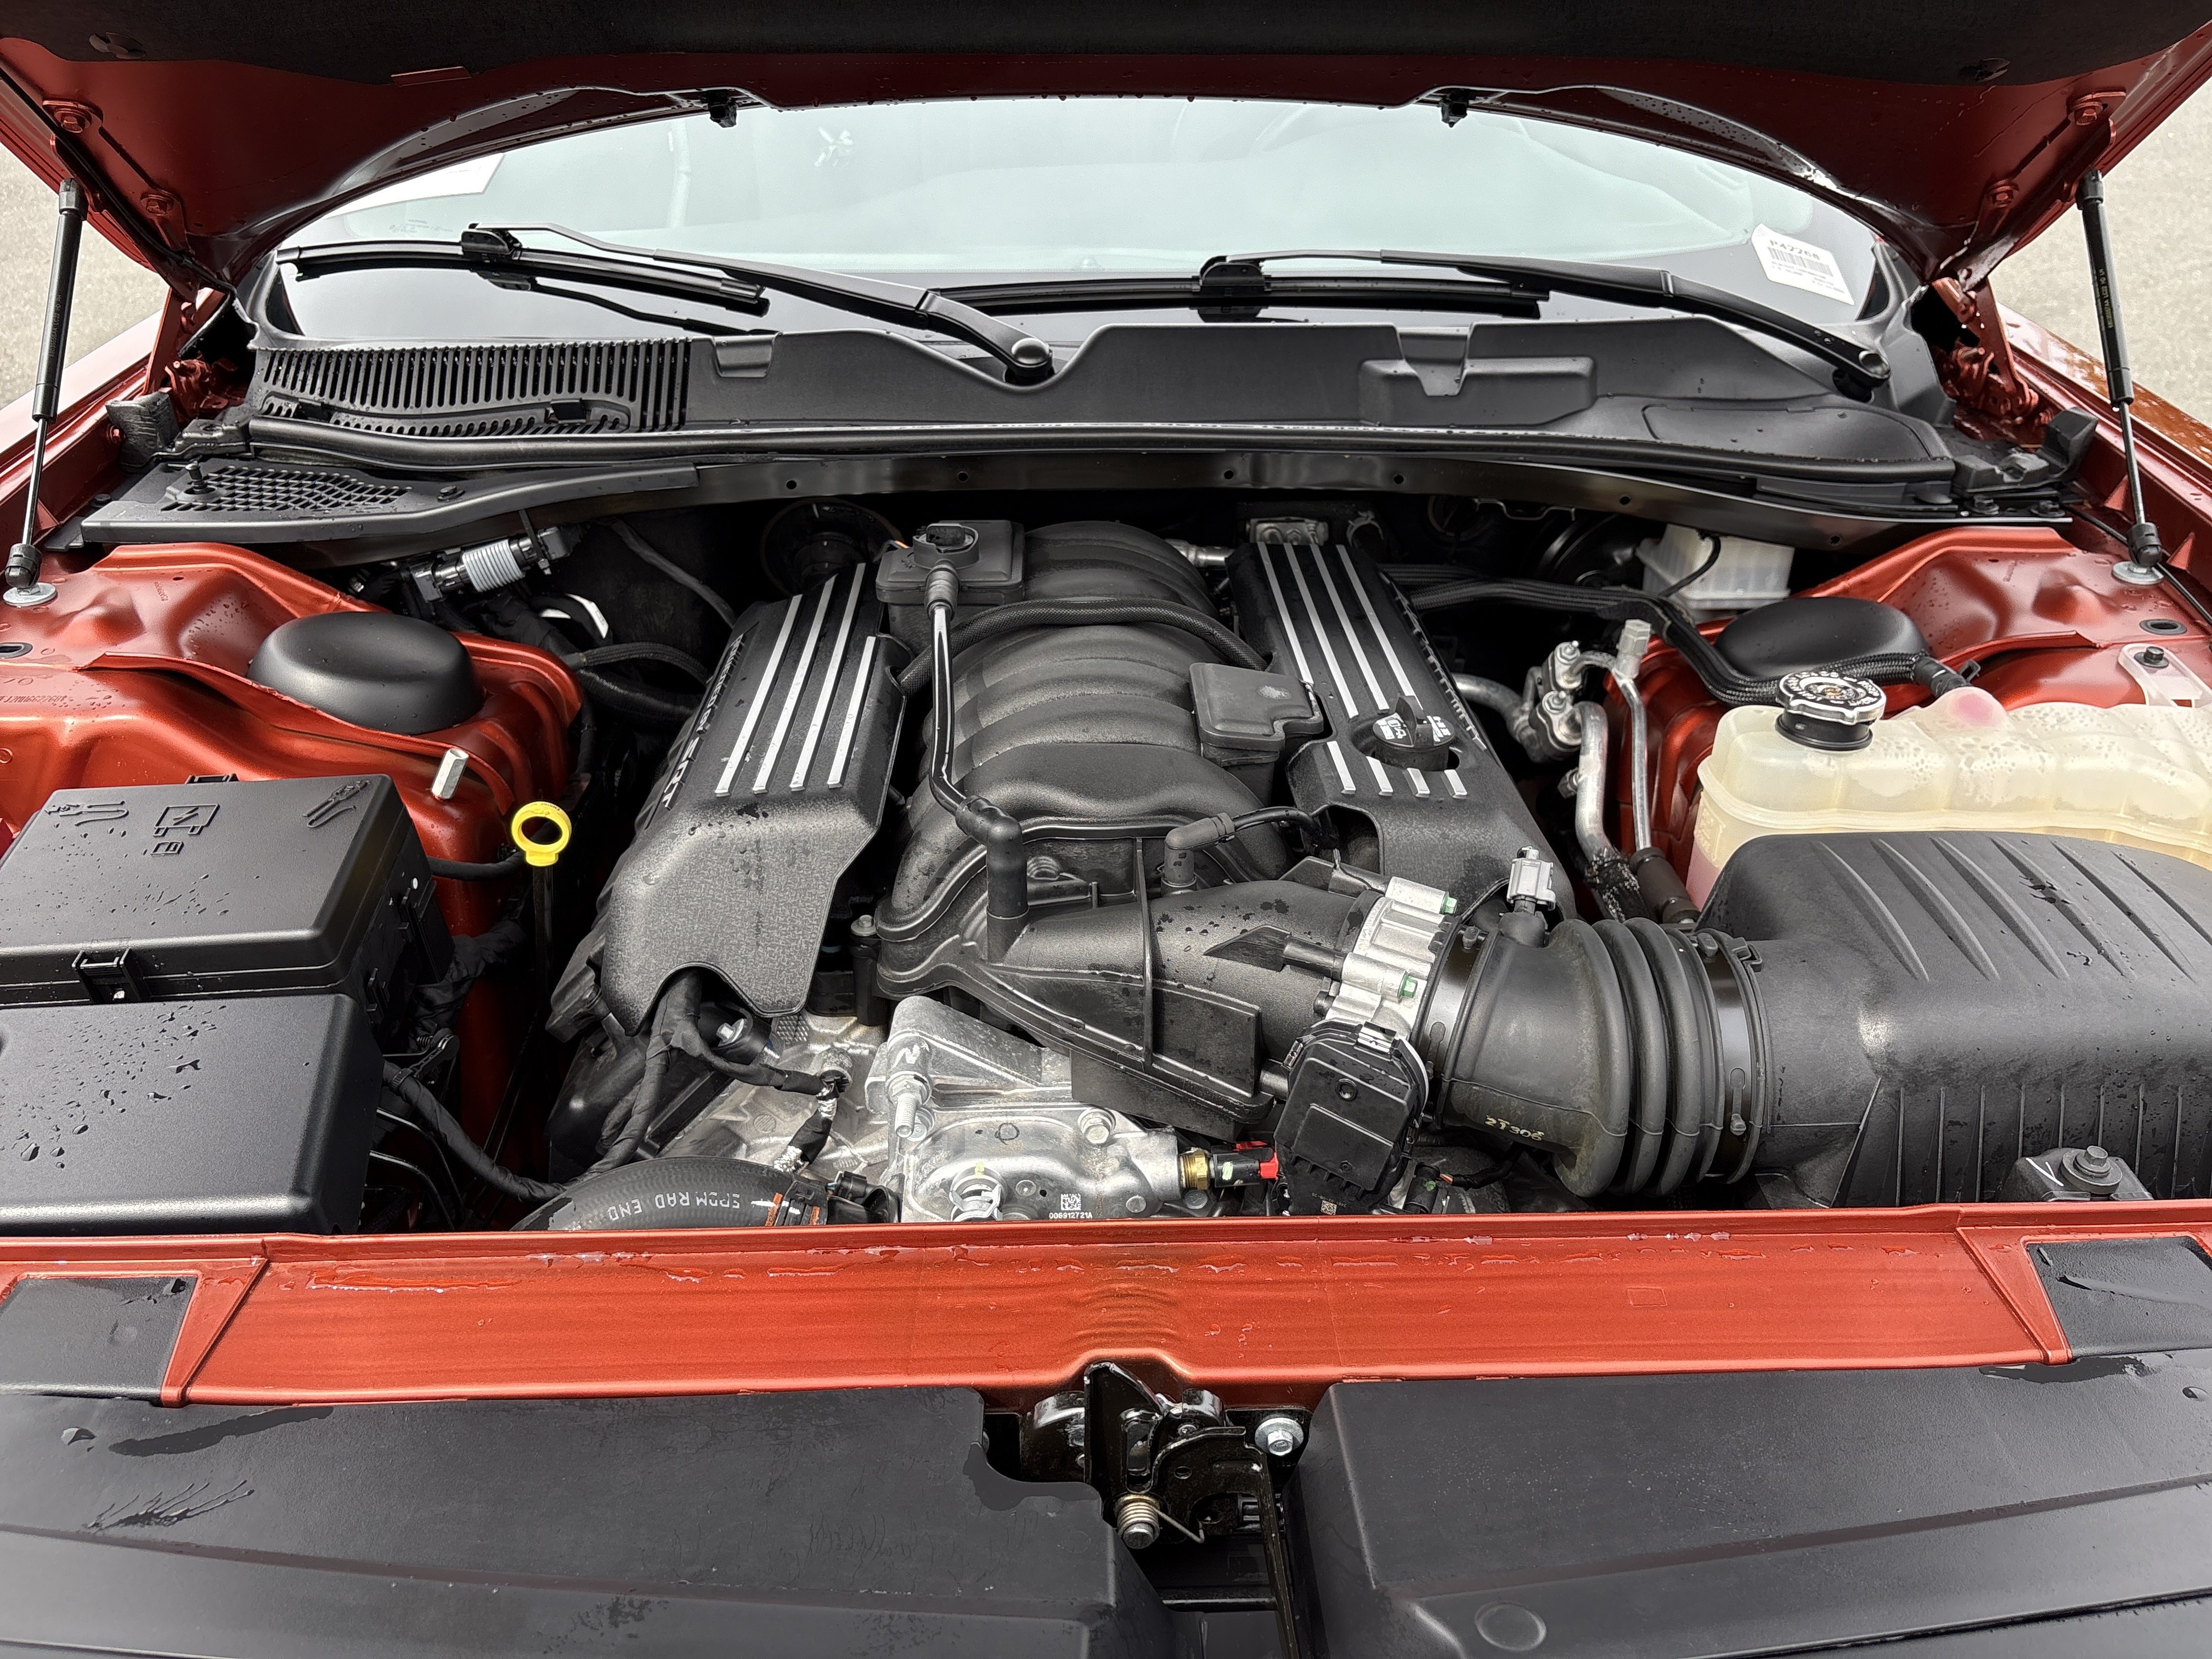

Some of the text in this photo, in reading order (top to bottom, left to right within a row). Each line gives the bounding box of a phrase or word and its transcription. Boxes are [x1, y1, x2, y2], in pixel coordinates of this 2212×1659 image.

[662, 633, 744, 808] POWERED BY SRT
[607, 1198, 643, 1221] END
[656, 1192, 690, 1209] RAD
